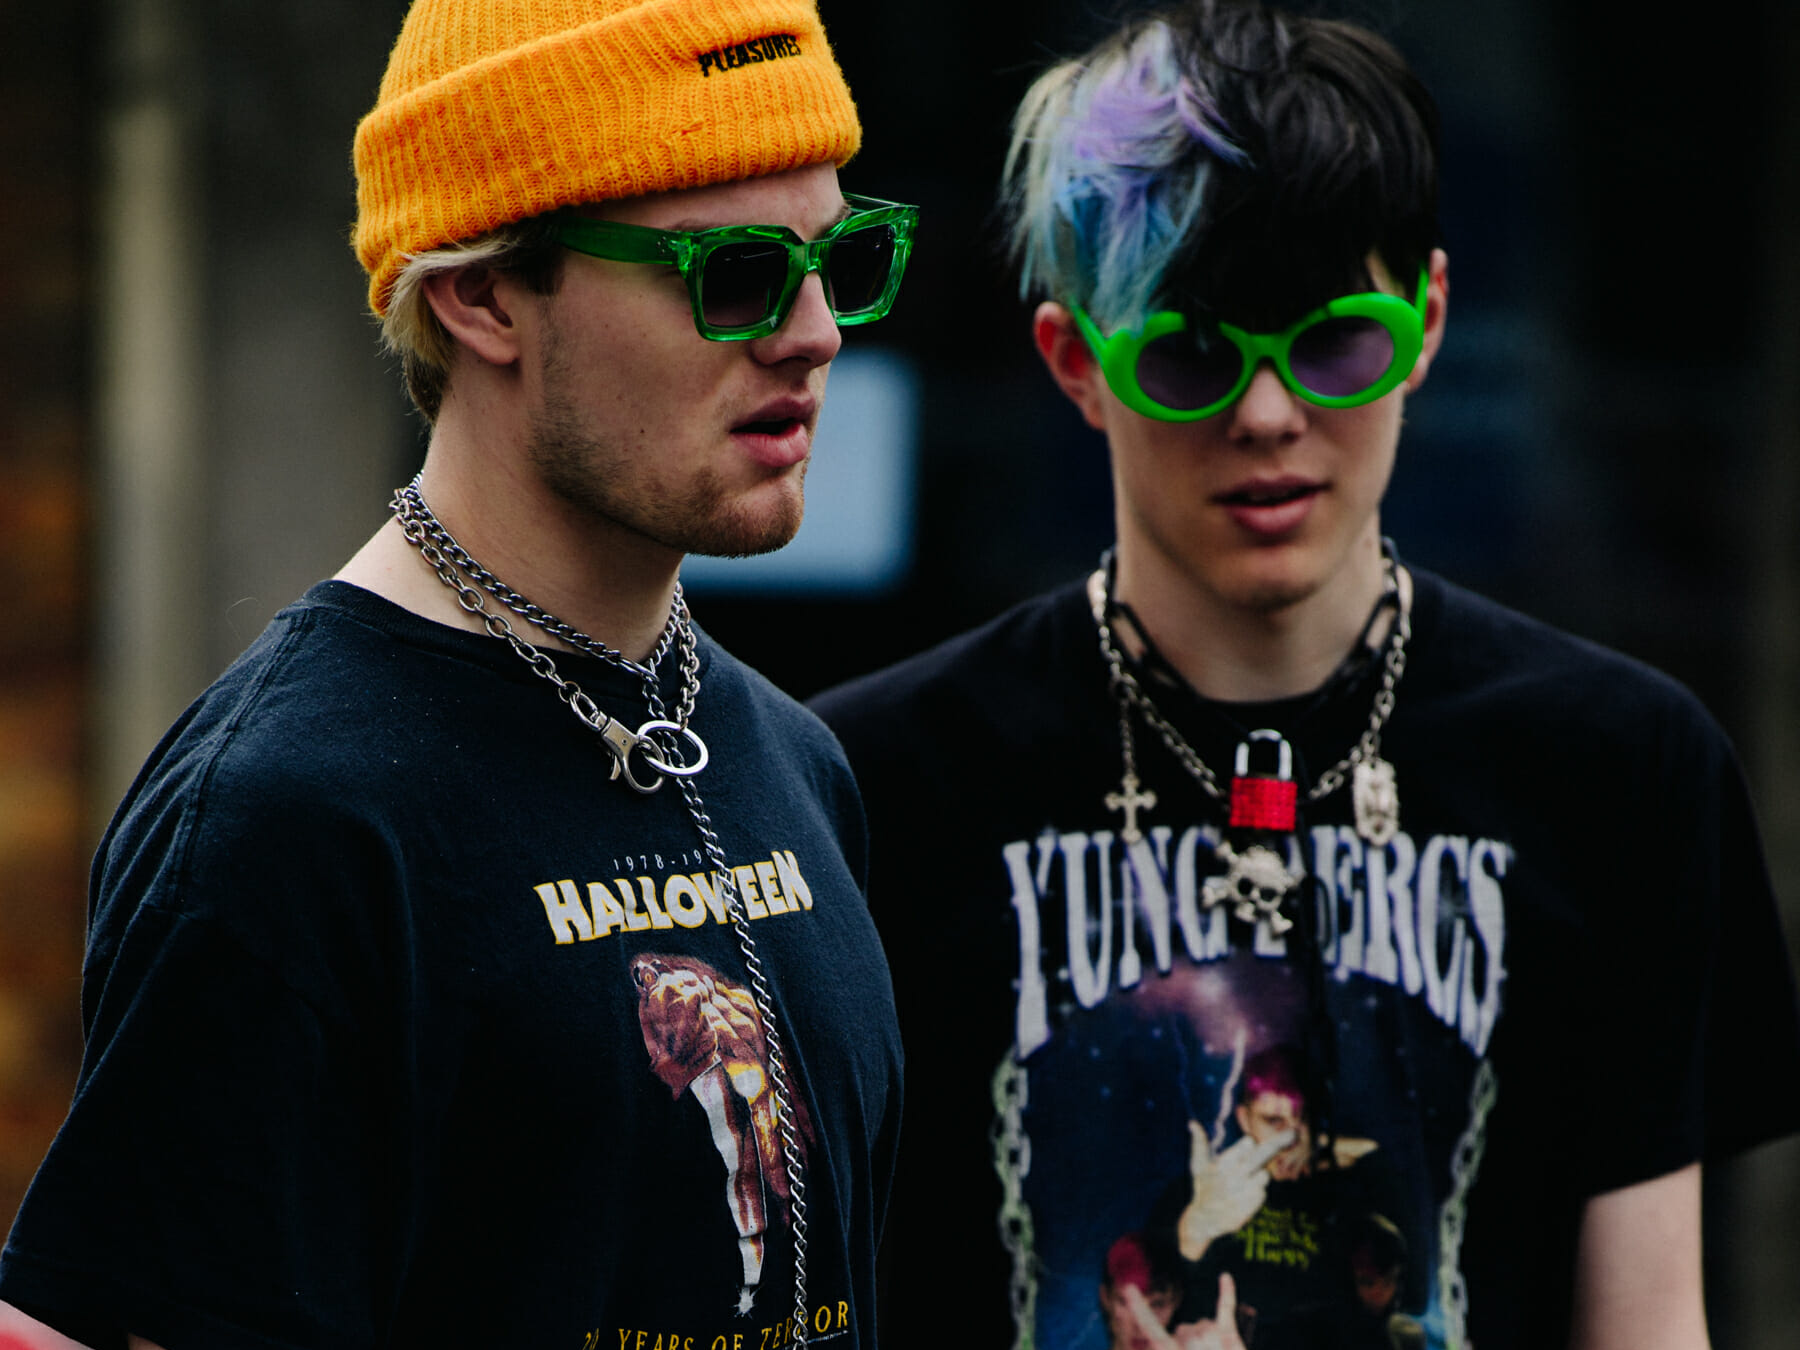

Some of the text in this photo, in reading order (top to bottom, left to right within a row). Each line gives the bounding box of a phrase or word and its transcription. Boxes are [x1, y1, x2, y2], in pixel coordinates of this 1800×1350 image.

[697, 33, 802, 77] PLEASURES
[612, 847, 722, 872] 1978-19
[533, 850, 813, 944] HALLOWEEN
